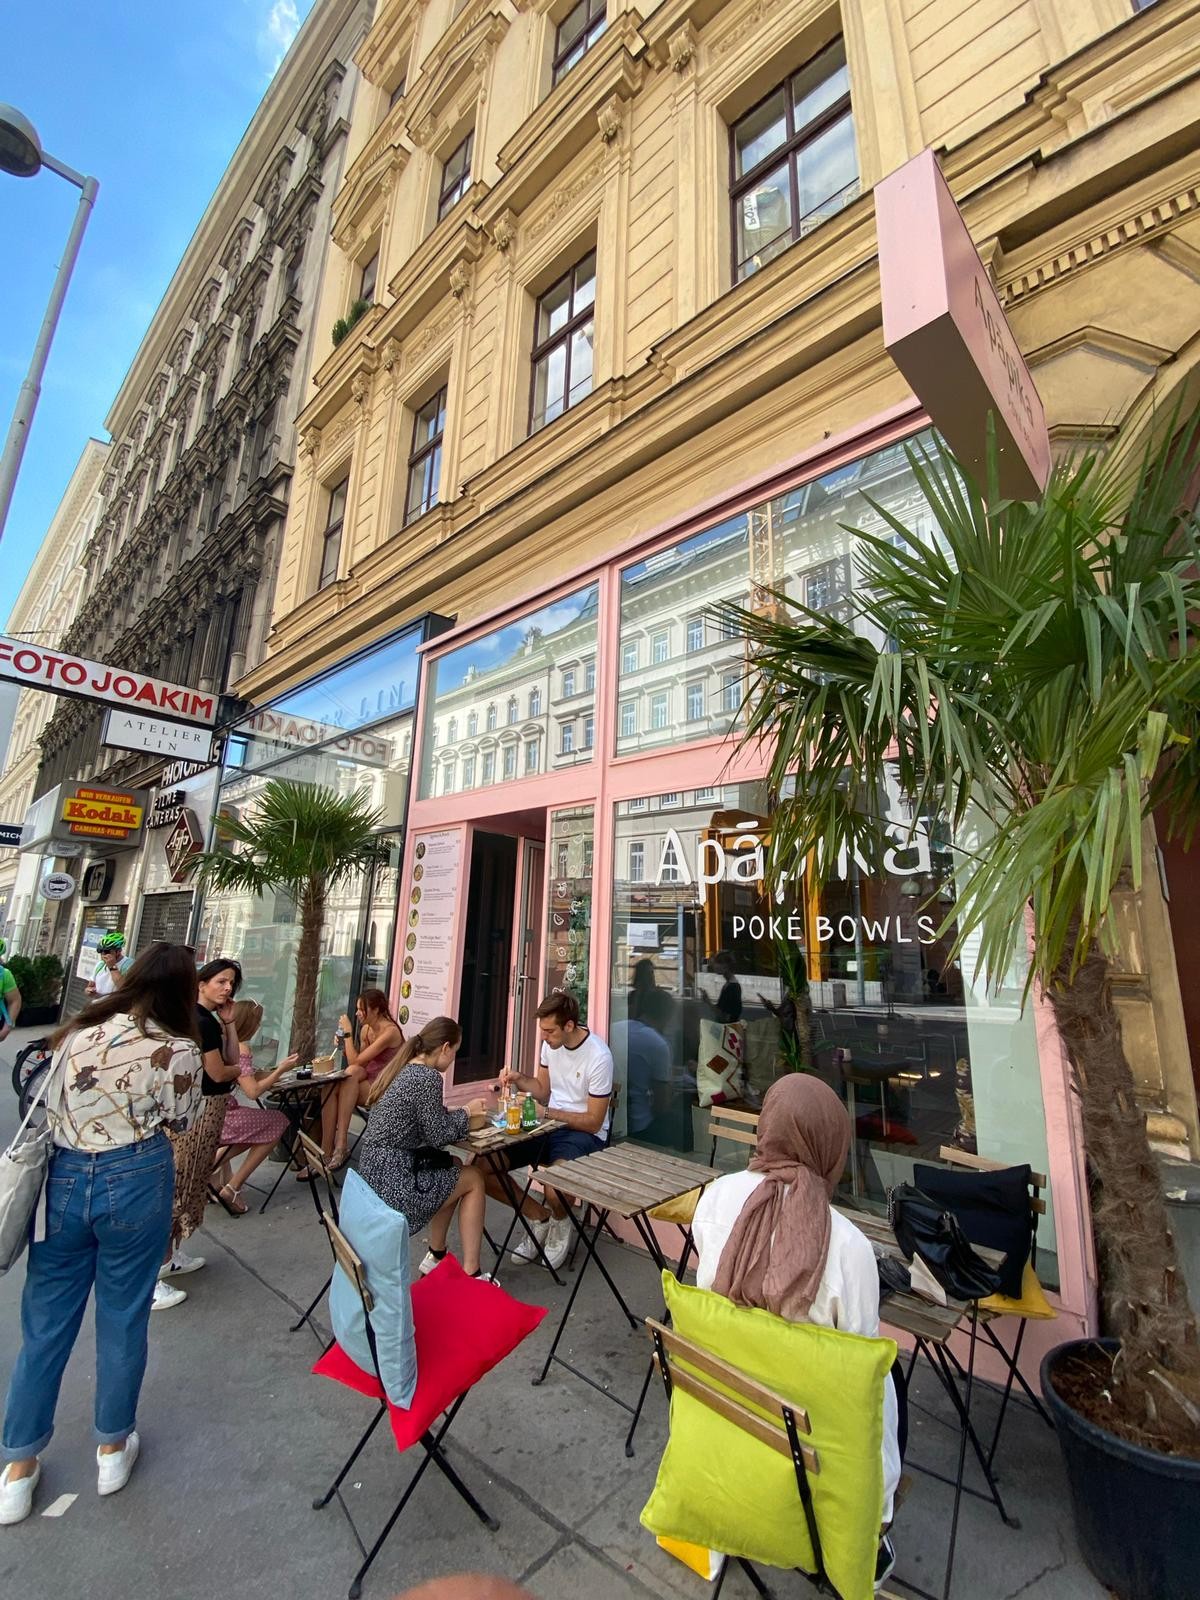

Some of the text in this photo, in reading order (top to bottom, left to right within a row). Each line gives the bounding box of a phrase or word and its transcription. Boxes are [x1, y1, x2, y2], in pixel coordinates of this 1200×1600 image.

[0, 642, 214, 719] FOTO JOAKIM
[123, 719, 201, 743] ATELIER
[143, 737, 178, 752] LIN
[67, 802, 137, 825] Kodak
[145, 806, 181, 829] CAMERAS
[732, 908, 936, 944] POKÉ BOWLS
